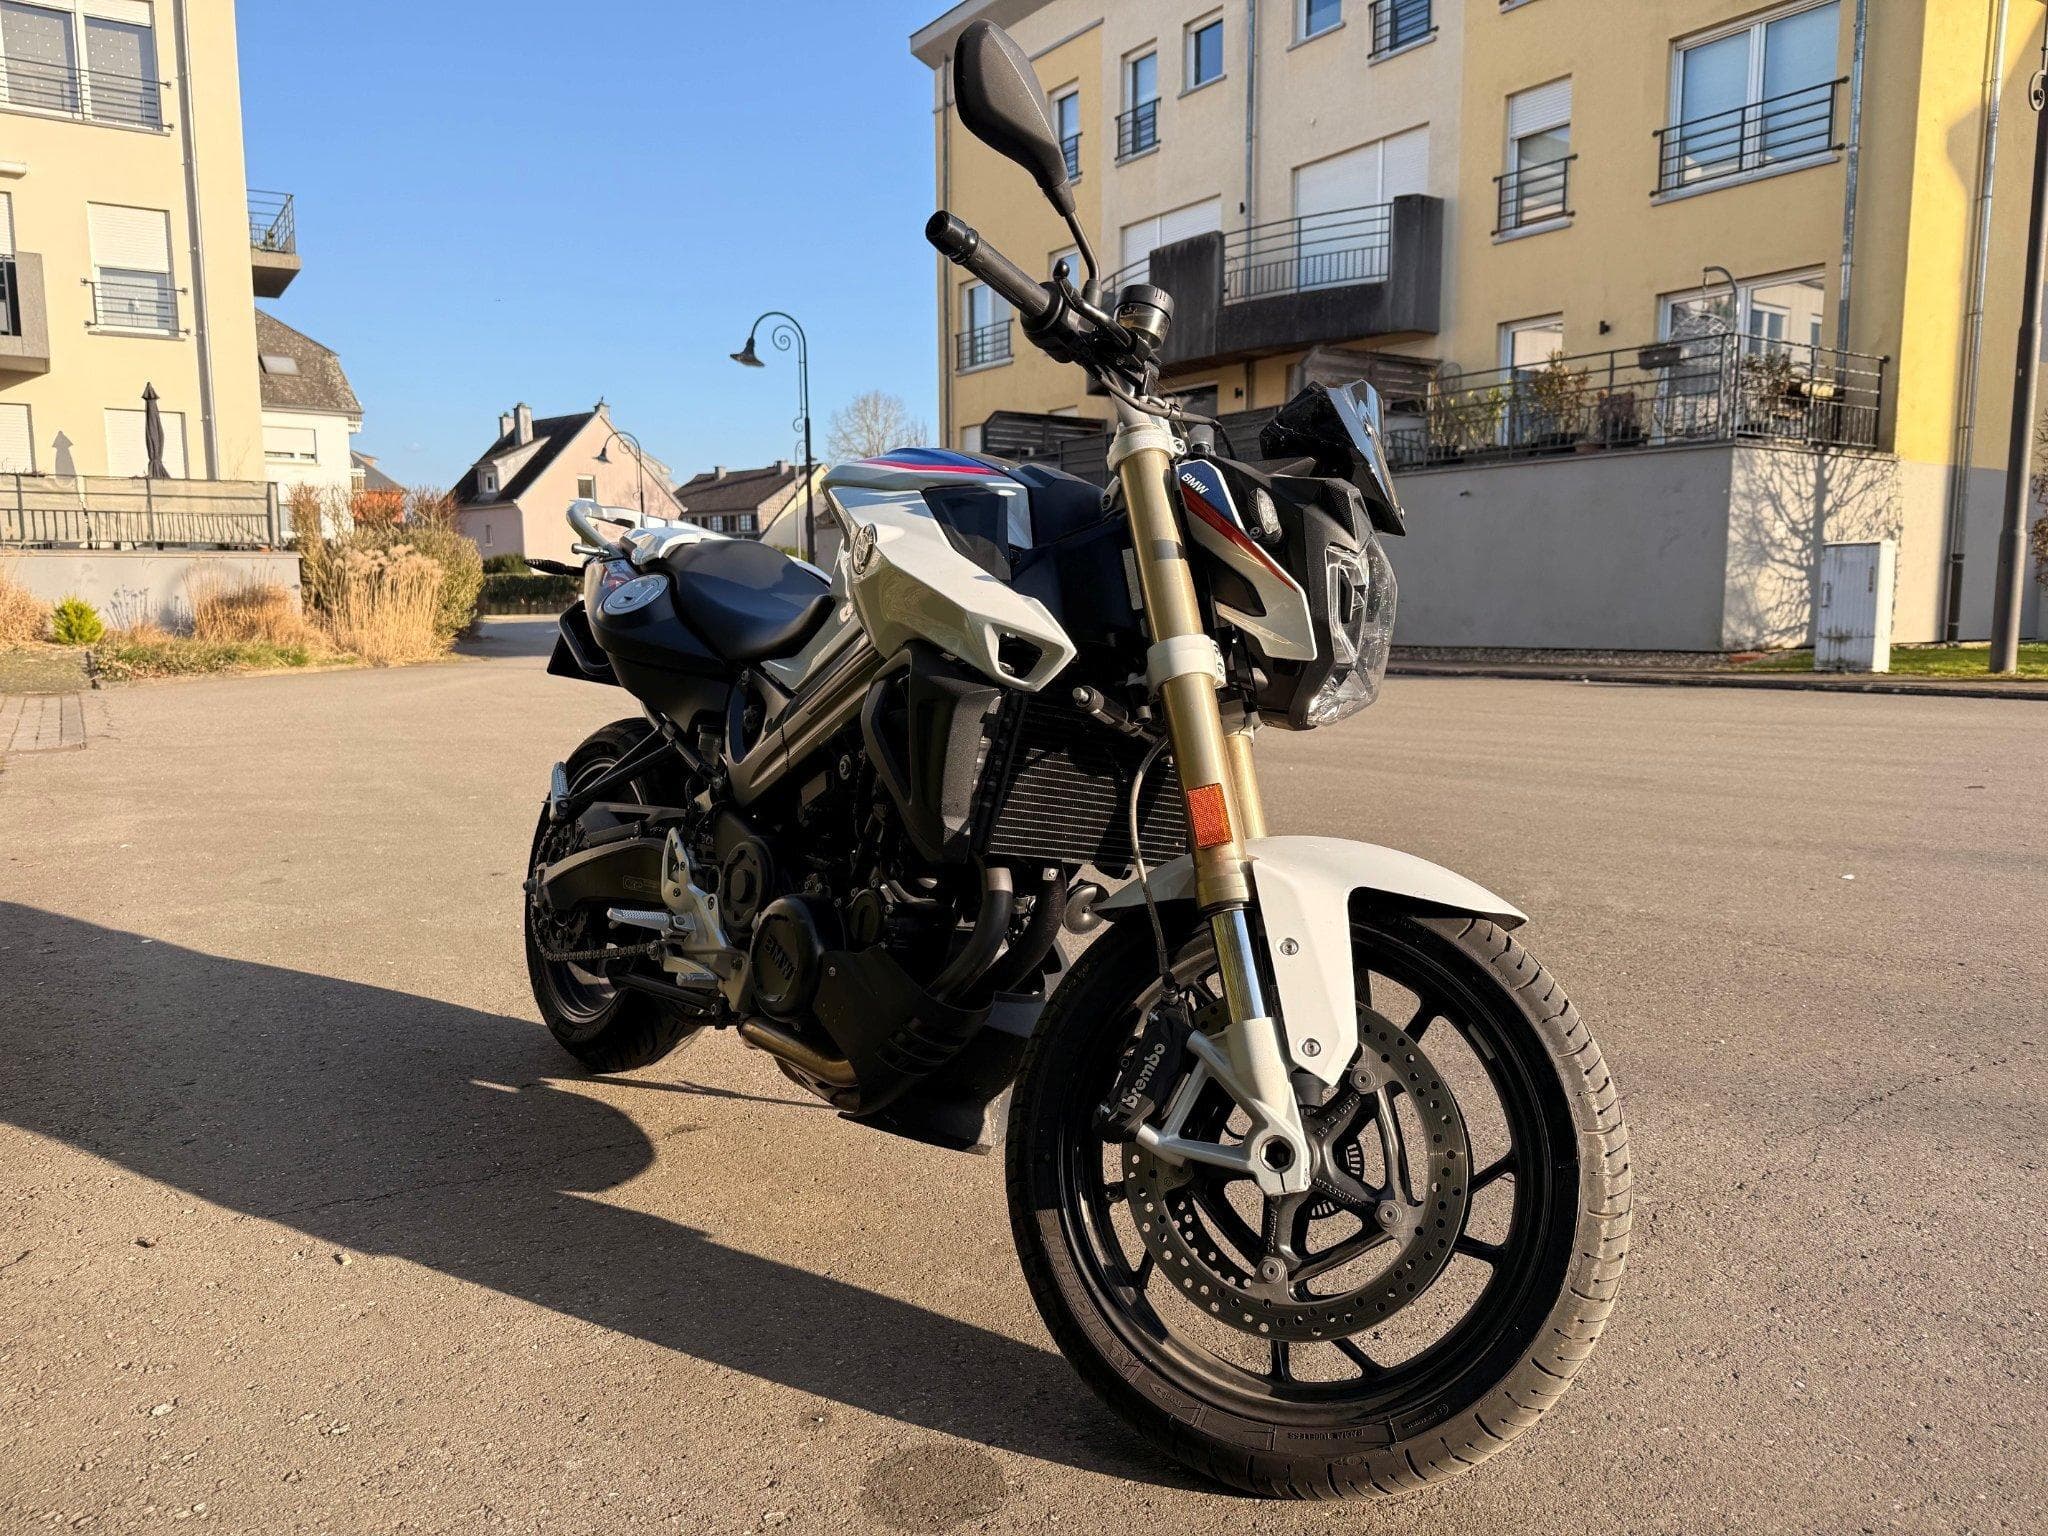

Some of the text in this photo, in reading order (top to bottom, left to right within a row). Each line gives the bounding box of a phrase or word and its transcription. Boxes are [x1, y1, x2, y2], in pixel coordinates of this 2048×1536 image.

[1181, 472, 1210, 494] BMW
[764, 935, 796, 980] BMW
[1121, 1043, 1166, 1109] brembo
